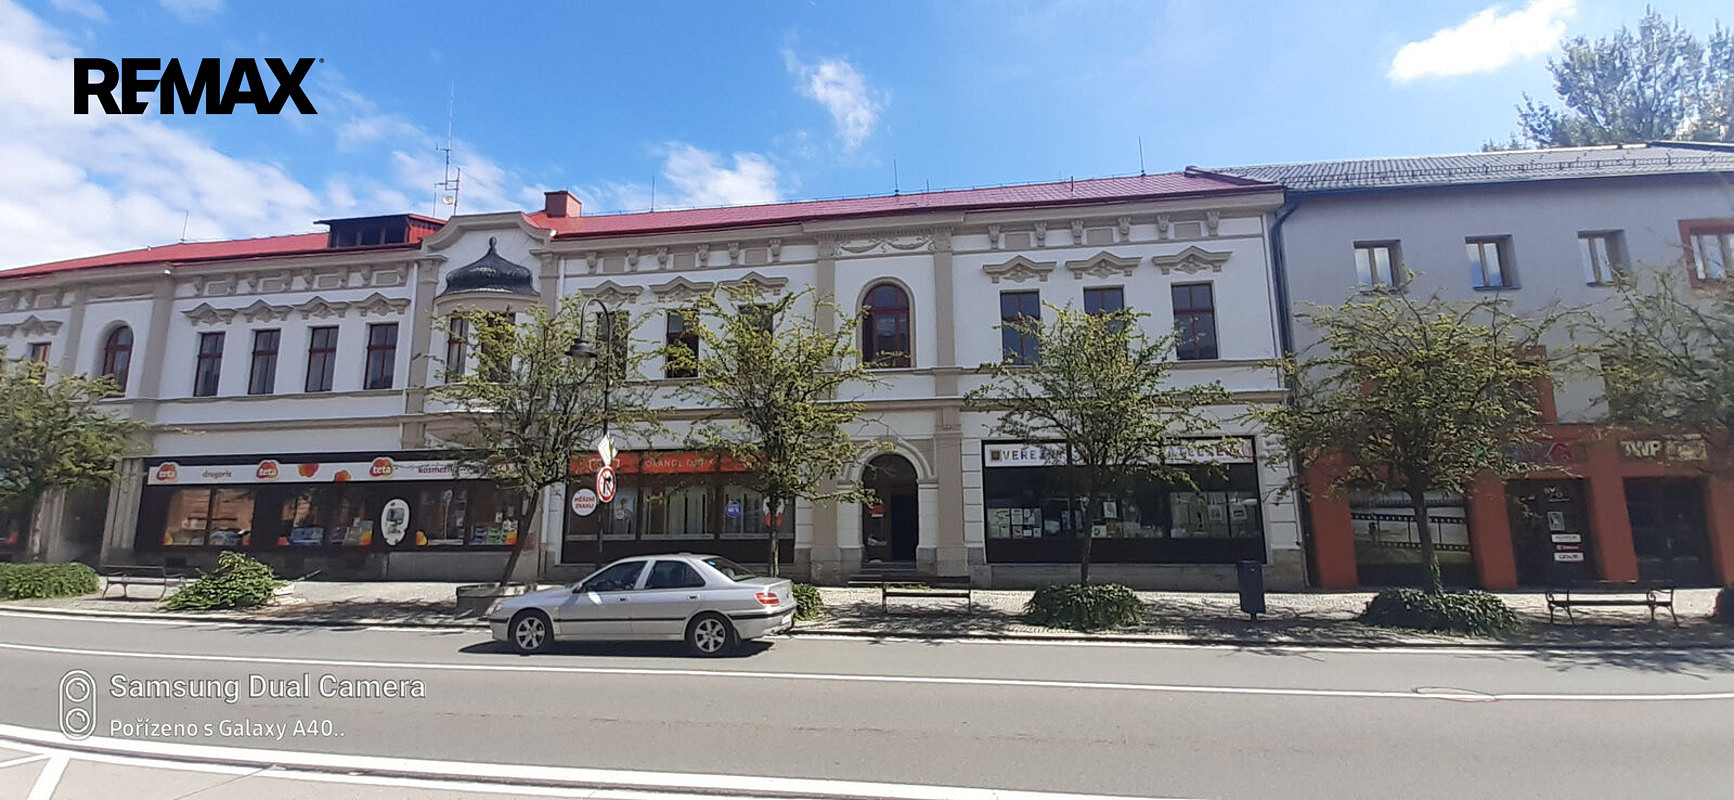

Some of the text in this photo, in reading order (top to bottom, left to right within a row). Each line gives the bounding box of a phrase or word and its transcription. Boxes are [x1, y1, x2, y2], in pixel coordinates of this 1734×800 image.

[202, 469, 232, 479] drogerie
[259, 468, 277, 476] teta
[372, 465, 391, 474] teta
